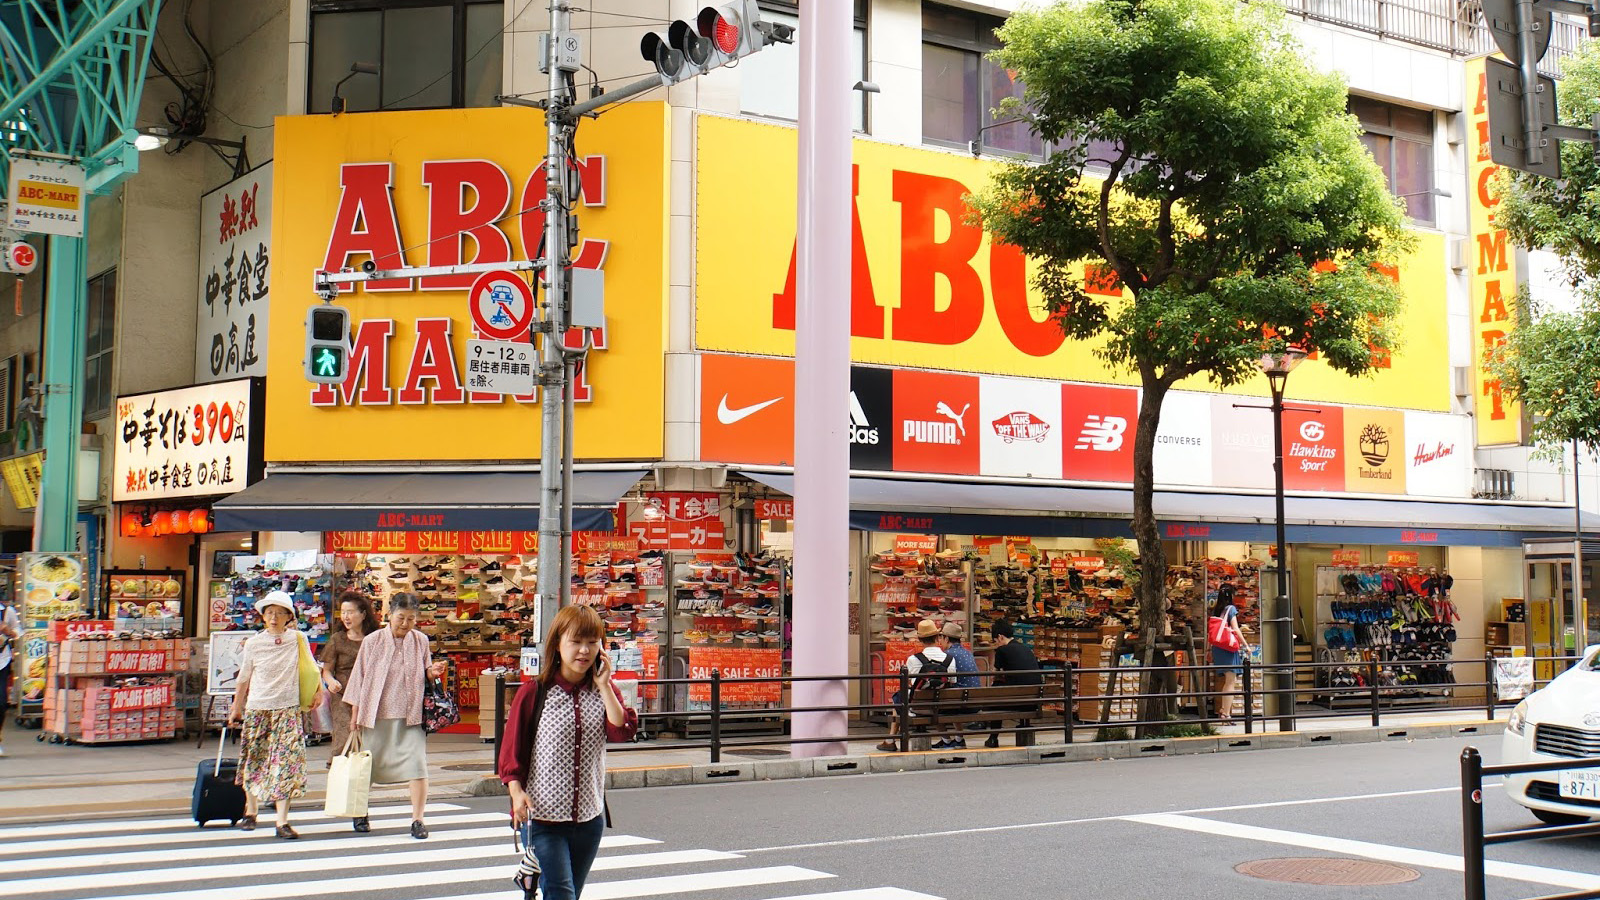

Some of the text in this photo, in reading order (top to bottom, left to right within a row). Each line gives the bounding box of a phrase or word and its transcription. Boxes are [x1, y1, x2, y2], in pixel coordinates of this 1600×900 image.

[18, 186, 78, 203] ABC-MART
[313, 155, 611, 293] ABC
[205, 241, 268, 317] 中華食堂
[210, 313, 258, 376] 日高屋
[469, 359, 531, 376] 居住者用車両
[469, 374, 494, 388] を除く
[1008, 413, 1031, 424] VANS
[849, 424, 879, 445] das
[903, 420, 957, 444] PUMA
[1157, 435, 1201, 446] CONVERSE
[1289, 442, 1336, 459] Hawkins
[1299, 459, 1327, 473] Sport
[1358, 466, 1392, 480] Timberland
[762, 503, 792, 518] SALE
[377, 512, 444, 528] ABC-MART
[878, 515, 933, 530] ABC-MART
[333, 531, 373, 552] SALE
[377, 531, 407, 552] ALE
[417, 531, 459, 552] SALE
[471, 531, 512, 552] SALE
[631, 526, 724, 546] スニーカー
[919, 541, 935, 549] SALE
[66, 623, 104, 639] SALE
[723, 667, 750, 678] SALE
[755, 668, 779, 678] SALE
